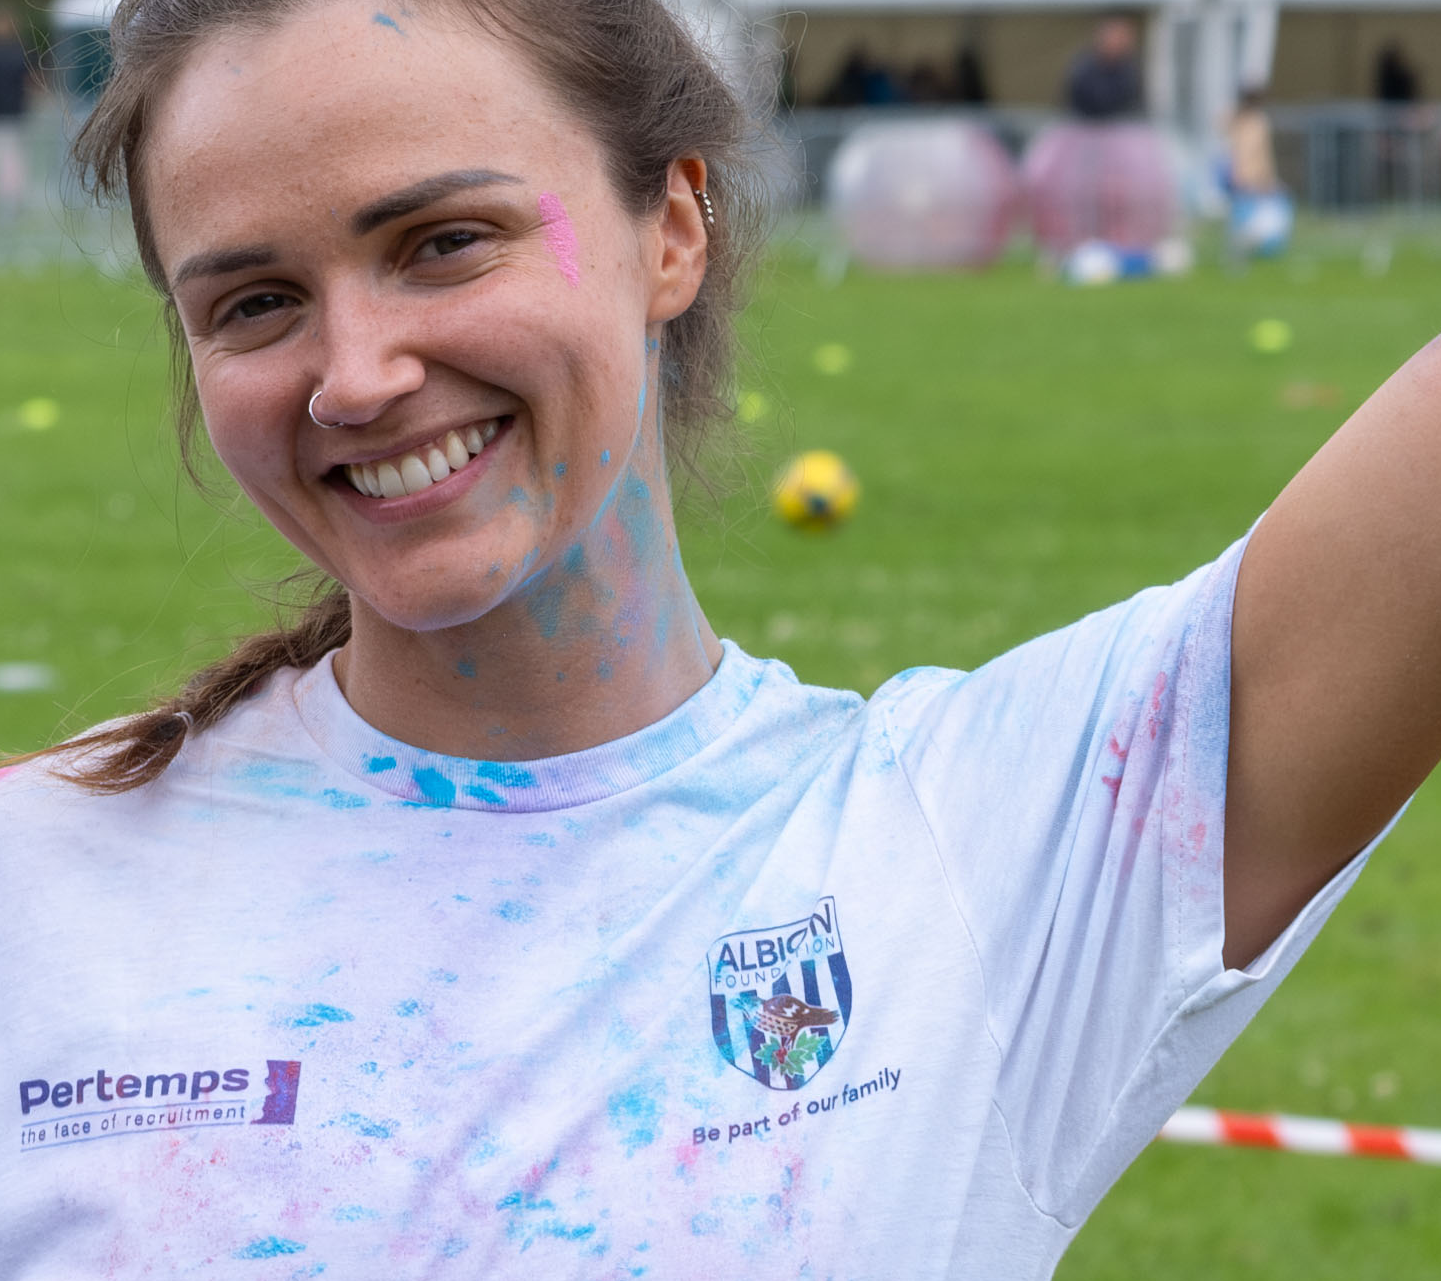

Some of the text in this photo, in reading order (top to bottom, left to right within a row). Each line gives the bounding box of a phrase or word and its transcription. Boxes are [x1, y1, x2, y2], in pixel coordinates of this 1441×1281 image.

[716, 903, 833, 973] ALBION
[19, 1067, 250, 1116] Pertemps
[692, 1066, 902, 1146] Be part of our family
[20, 1104, 247, 1146] the face of recruitment
